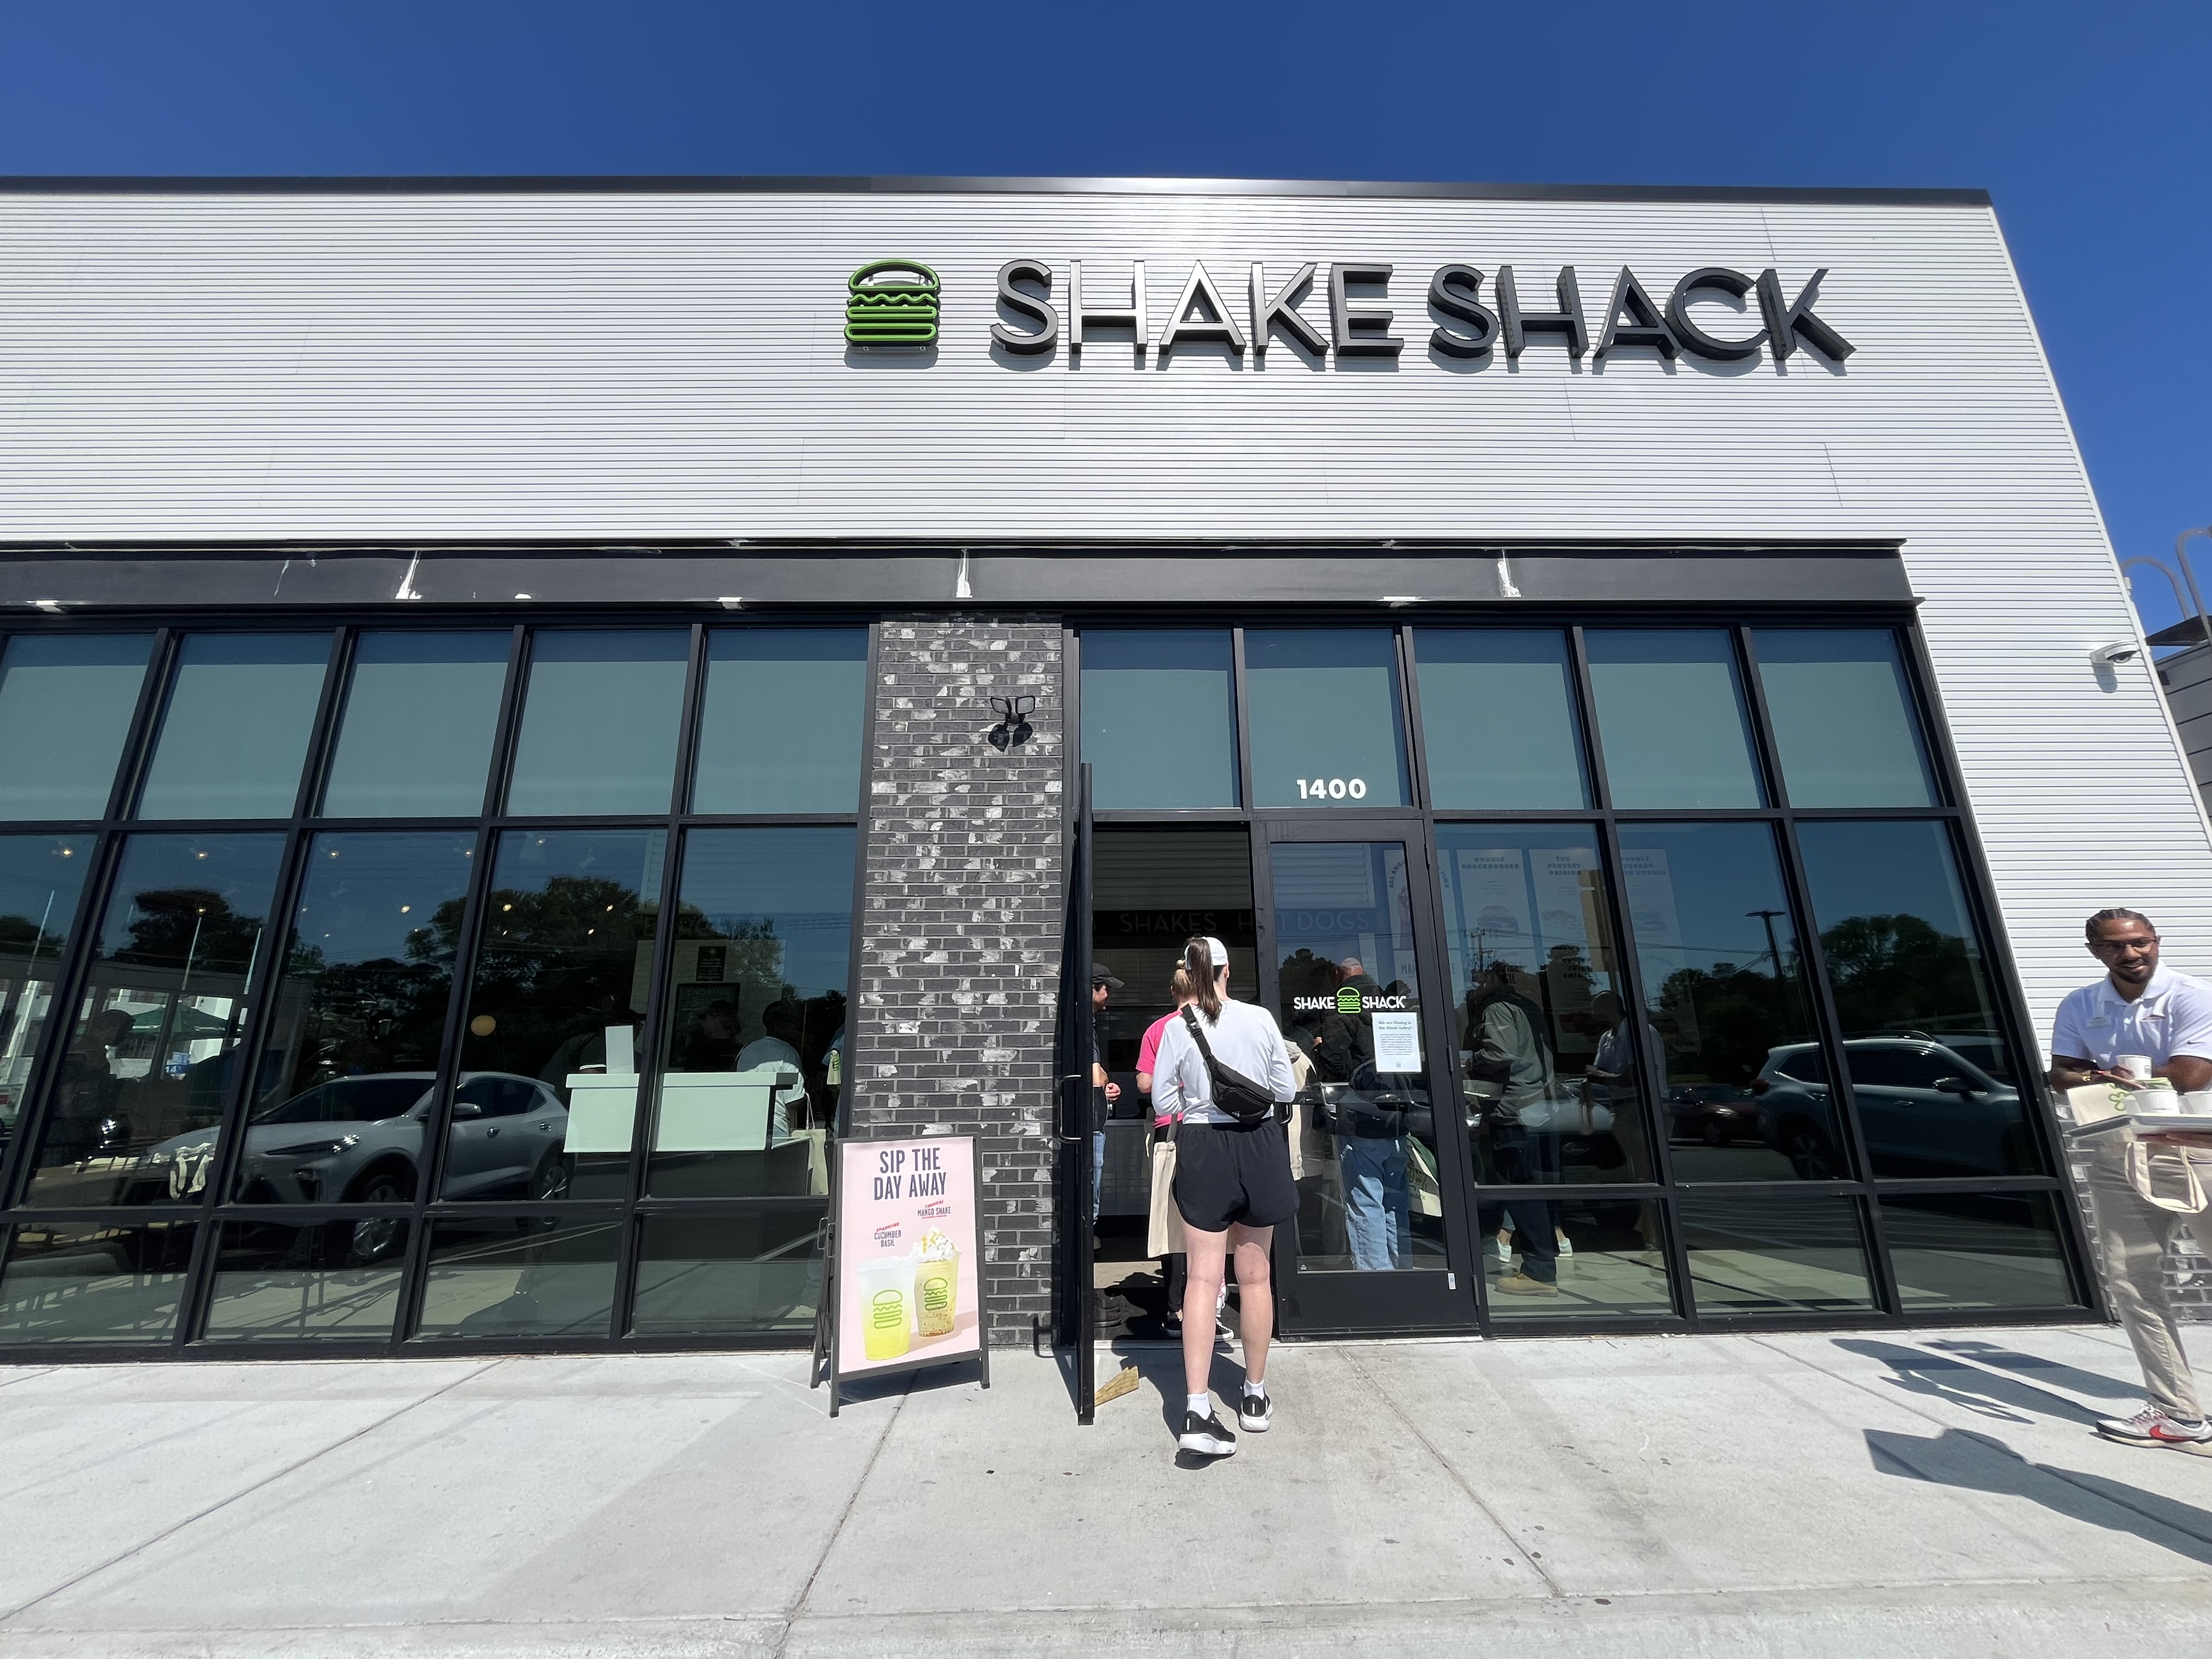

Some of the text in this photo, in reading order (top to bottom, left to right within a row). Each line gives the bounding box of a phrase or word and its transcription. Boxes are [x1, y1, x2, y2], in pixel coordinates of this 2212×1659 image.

[989, 259, 1857, 360] SHAKE SHACK
[1296, 778, 1367, 799] 1400
[1120, 911, 1370, 933] SHAKES HT DOGS
[1294, 995, 1406, 1010] SHAKE SHACK
[879, 1147, 940, 1173] SIP THE
[874, 1172, 946, 1200] DAY AWAY
[917, 1207, 934, 1217] MANGO
[936, 1206, 951, 1215] SHAKE
[874, 1229, 901, 1240] CUCUMBER
[881, 1239, 895, 1248] BASIL
